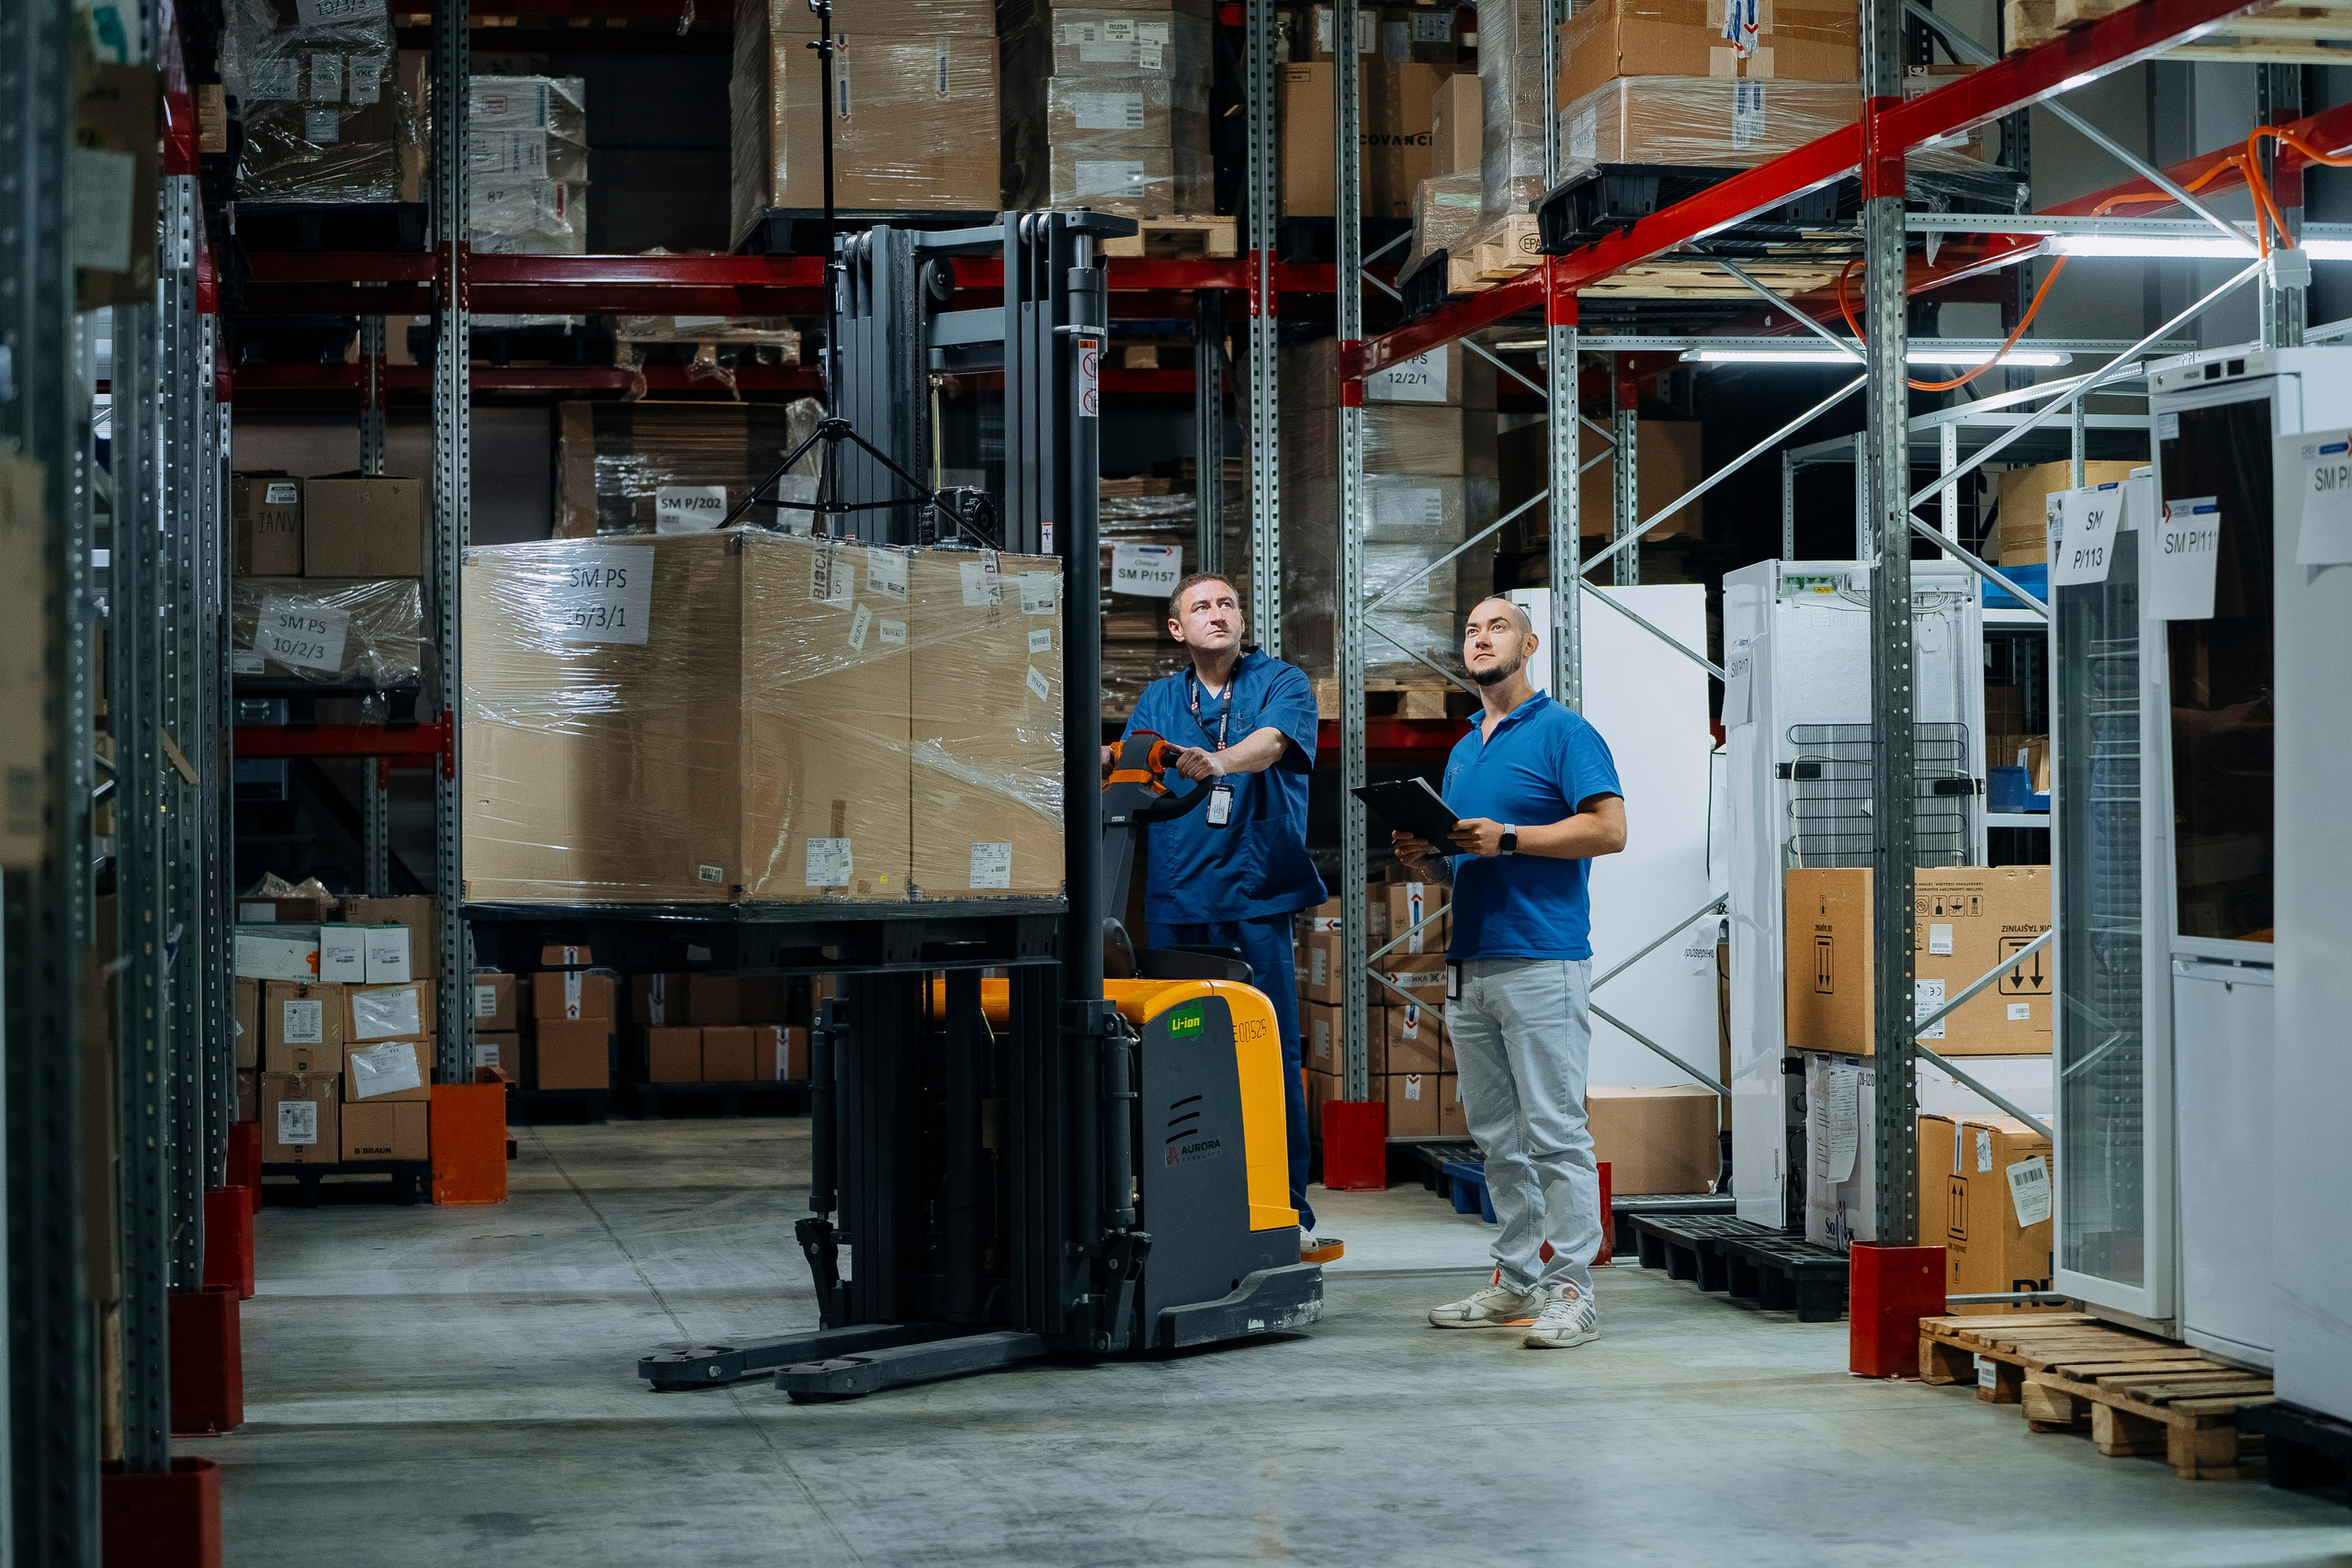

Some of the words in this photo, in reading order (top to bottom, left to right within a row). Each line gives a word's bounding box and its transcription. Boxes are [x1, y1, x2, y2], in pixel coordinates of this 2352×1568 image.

[1360, 133, 1432, 146] COVANC
[487, 191, 504, 203] 87
[1387, 373, 1427, 384] 12/2/1
[2314, 467, 2335, 491] SM
[661, 498, 682, 509] SM
[684, 497, 721, 510] P/202
[2086, 509, 2104, 531] SM
[2164, 532, 2186, 554] SM
[2073, 547, 2103, 570] P/113
[569, 568, 599, 588] SM
[605, 568, 628, 588] PS
[1118, 568, 1137, 580] SM
[1140, 570, 1175, 581] P/157
[278, 615, 304, 630] SM
[308, 619, 326, 634] PS
[272, 637, 324, 660] 10/2/3
[1171, 1016, 1200, 1031] Li-ion
[1181, 1139, 1221, 1155] AURORA
